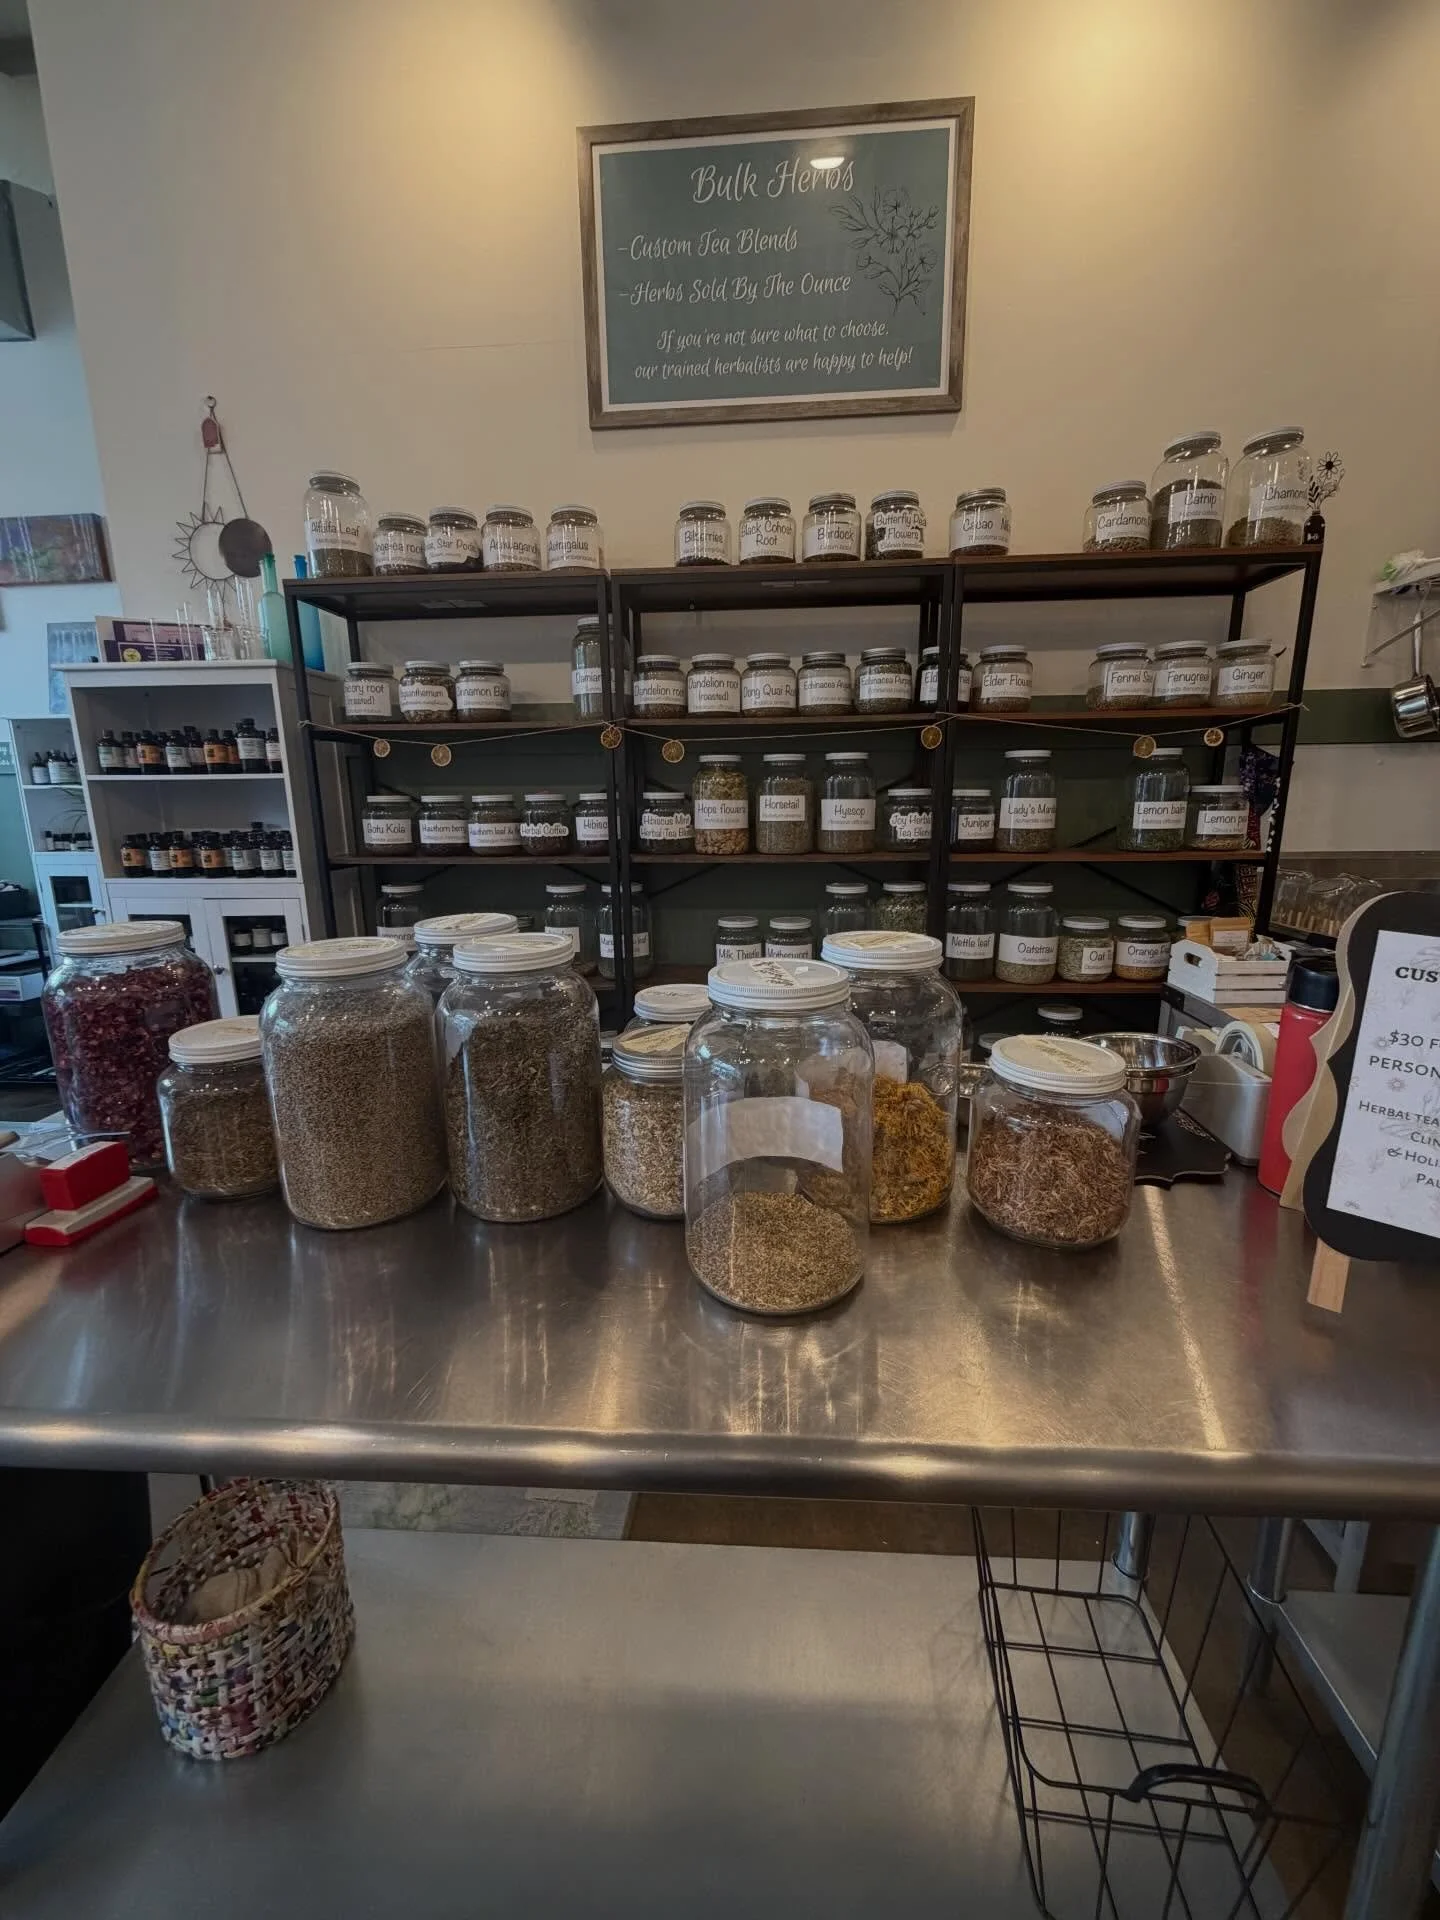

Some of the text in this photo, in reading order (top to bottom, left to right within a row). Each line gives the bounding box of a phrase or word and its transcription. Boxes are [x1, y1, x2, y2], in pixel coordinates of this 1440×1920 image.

[691, 158, 855, 204] Bulk Herbs
[697, 228, 729, 256] Tea
[736, 226, 798, 255] Blends
[689, 278, 727, 304] Sold
[731, 276, 758, 304] By
[763, 272, 794, 300] The
[800, 272, 851, 296] Ounce
[656, 330, 676, 354] If
[677, 330, 720, 354] you're
[725, 330, 746, 347] not
[750, 328, 780, 345] sure
[784, 325, 819, 344] what
[823, 324, 837, 341] to
[635, 346, 914, 381] our trained herbalists are happy to help!
[1184, 492, 1218, 509] Catnip
[876, 513, 911, 529] Butterfly
[340, 522, 360, 537] Leaf
[888, 528, 919, 540] Flowers
[756, 534, 778, 547] Root
[984, 675, 1007, 687] Elder
[1110, 671, 1142, 683] Fennel
[1230, 667, 1266, 684] Ginger
[366, 684, 386, 695] root
[697, 803, 718, 818] Hops
[764, 797, 801, 810] Horsetail
[834, 803, 866, 819] Hyssop
[1008, 803, 1038, 818] Lady's
[1137, 803, 1169, 816] Lemon
[962, 817, 992, 832] Juniper
[1204, 814, 1236, 825] Lemon
[542, 824, 568, 836] Coffee
[898, 827, 912, 838] Tea
[952, 934, 992, 948] Nettle leaf
[1018, 942, 1055, 954] Oatstraw
[1089, 950, 1106, 962] Oat
[1127, 945, 1159, 959] Orange
[1395, 966, 1440, 984] CUS
[1388, 1029, 1424, 1047] $30
